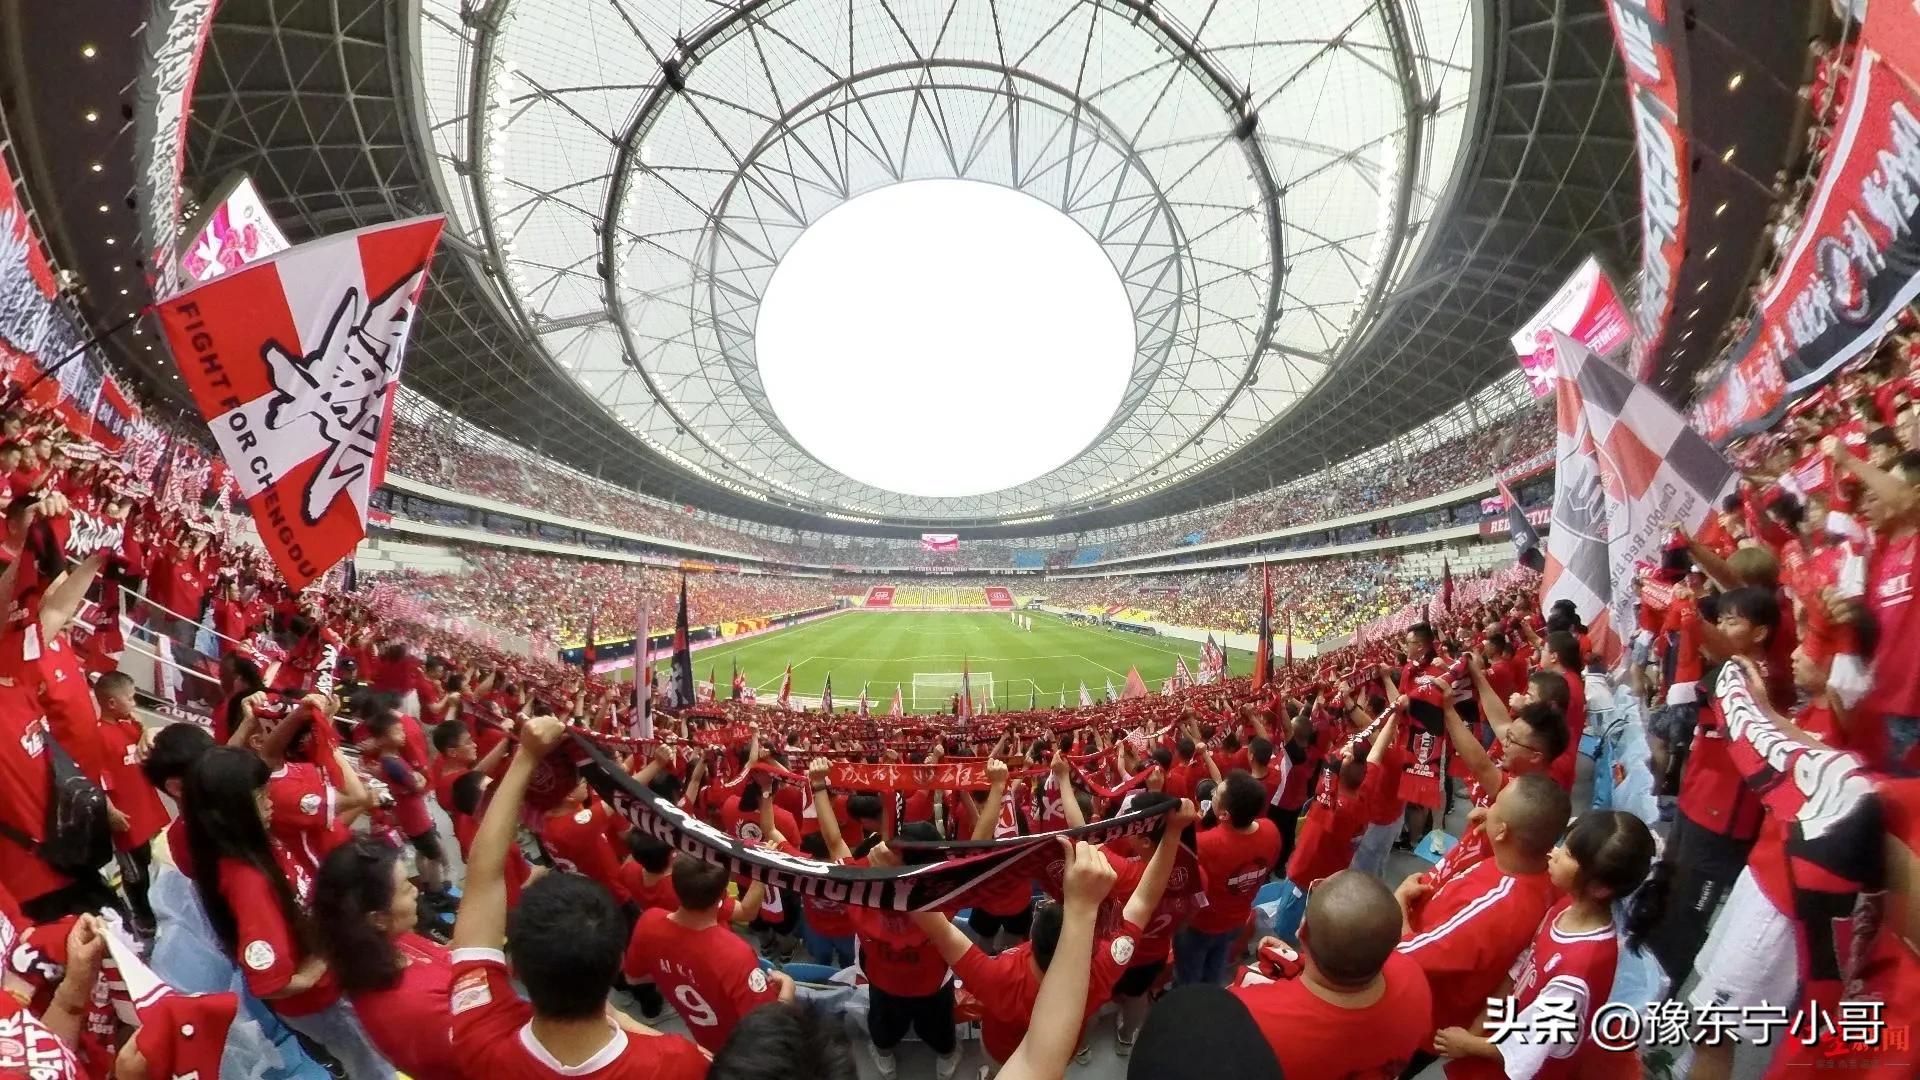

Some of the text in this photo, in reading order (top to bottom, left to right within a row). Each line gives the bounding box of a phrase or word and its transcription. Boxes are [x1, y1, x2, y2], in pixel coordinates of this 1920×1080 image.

[176, 301, 231, 390] FIGHT
[222, 396, 258, 453] FOR
[250, 456, 318, 578] CHENGDU
[837, 765, 902, 787] 成都
[675, 984, 718, 1026] 9
